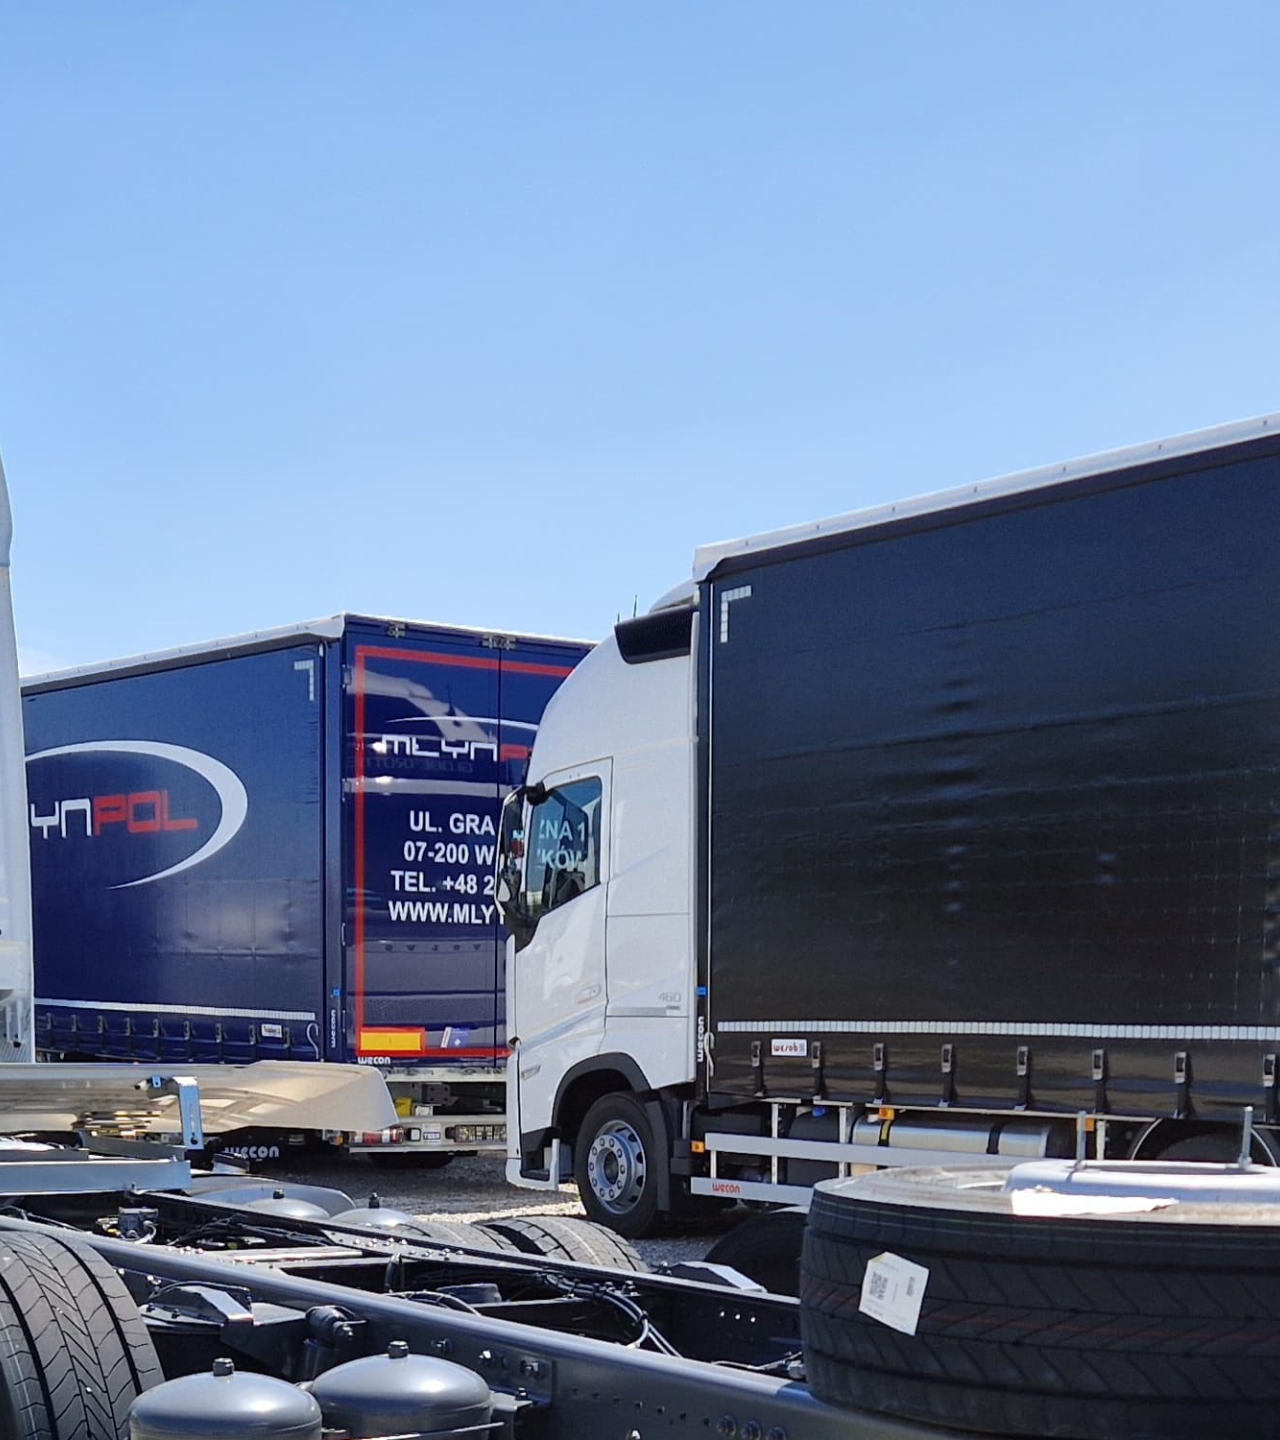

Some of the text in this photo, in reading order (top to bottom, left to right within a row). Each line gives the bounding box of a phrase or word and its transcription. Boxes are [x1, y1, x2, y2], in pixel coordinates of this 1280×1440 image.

[409, 810, 442, 833] UL.
[403, 841, 469, 865] 07-200
[390, 870, 436, 893] TEL.
[443, 874, 477, 894] +48
[711, 1182, 741, 1193] wecon
